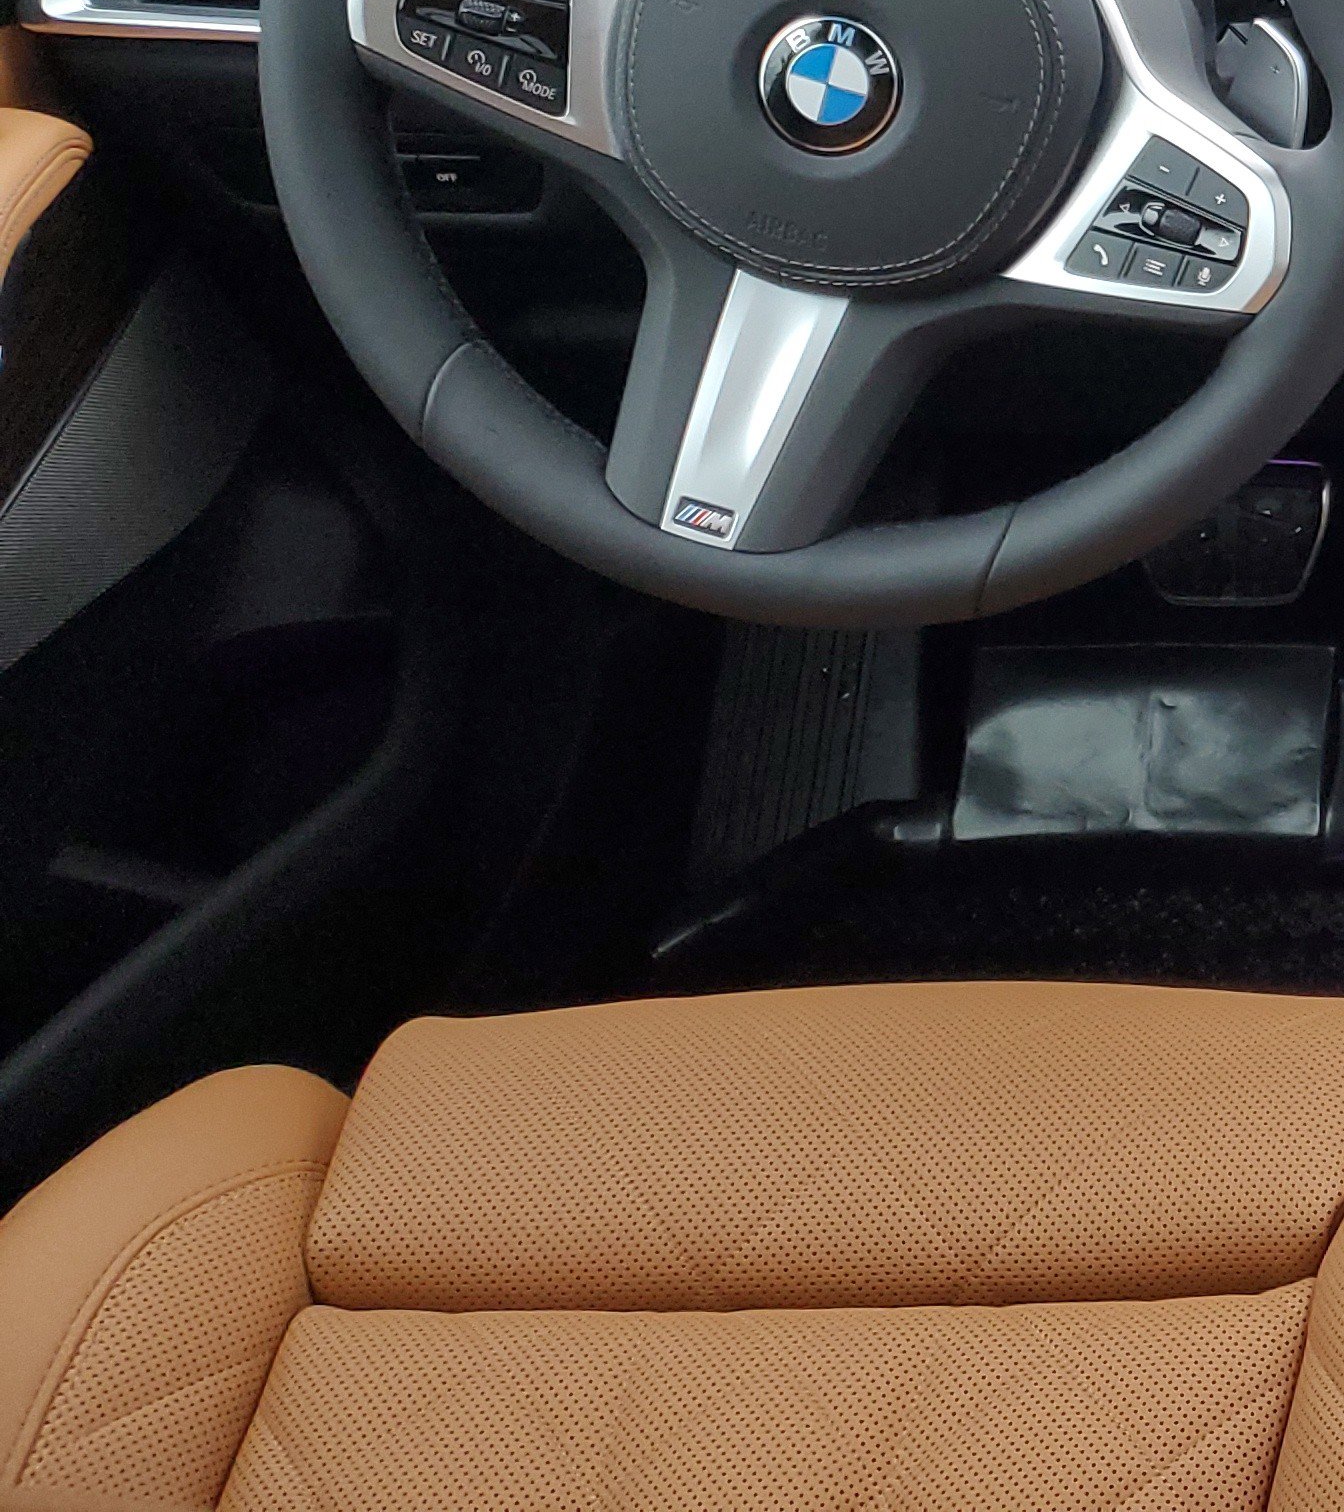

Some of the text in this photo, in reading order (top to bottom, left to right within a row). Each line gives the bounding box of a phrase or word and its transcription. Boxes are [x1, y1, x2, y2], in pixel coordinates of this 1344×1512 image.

[410, 29, 437, 48] SET
[785, 23, 890, 76] BMW
[522, 80, 556, 101] MODE
